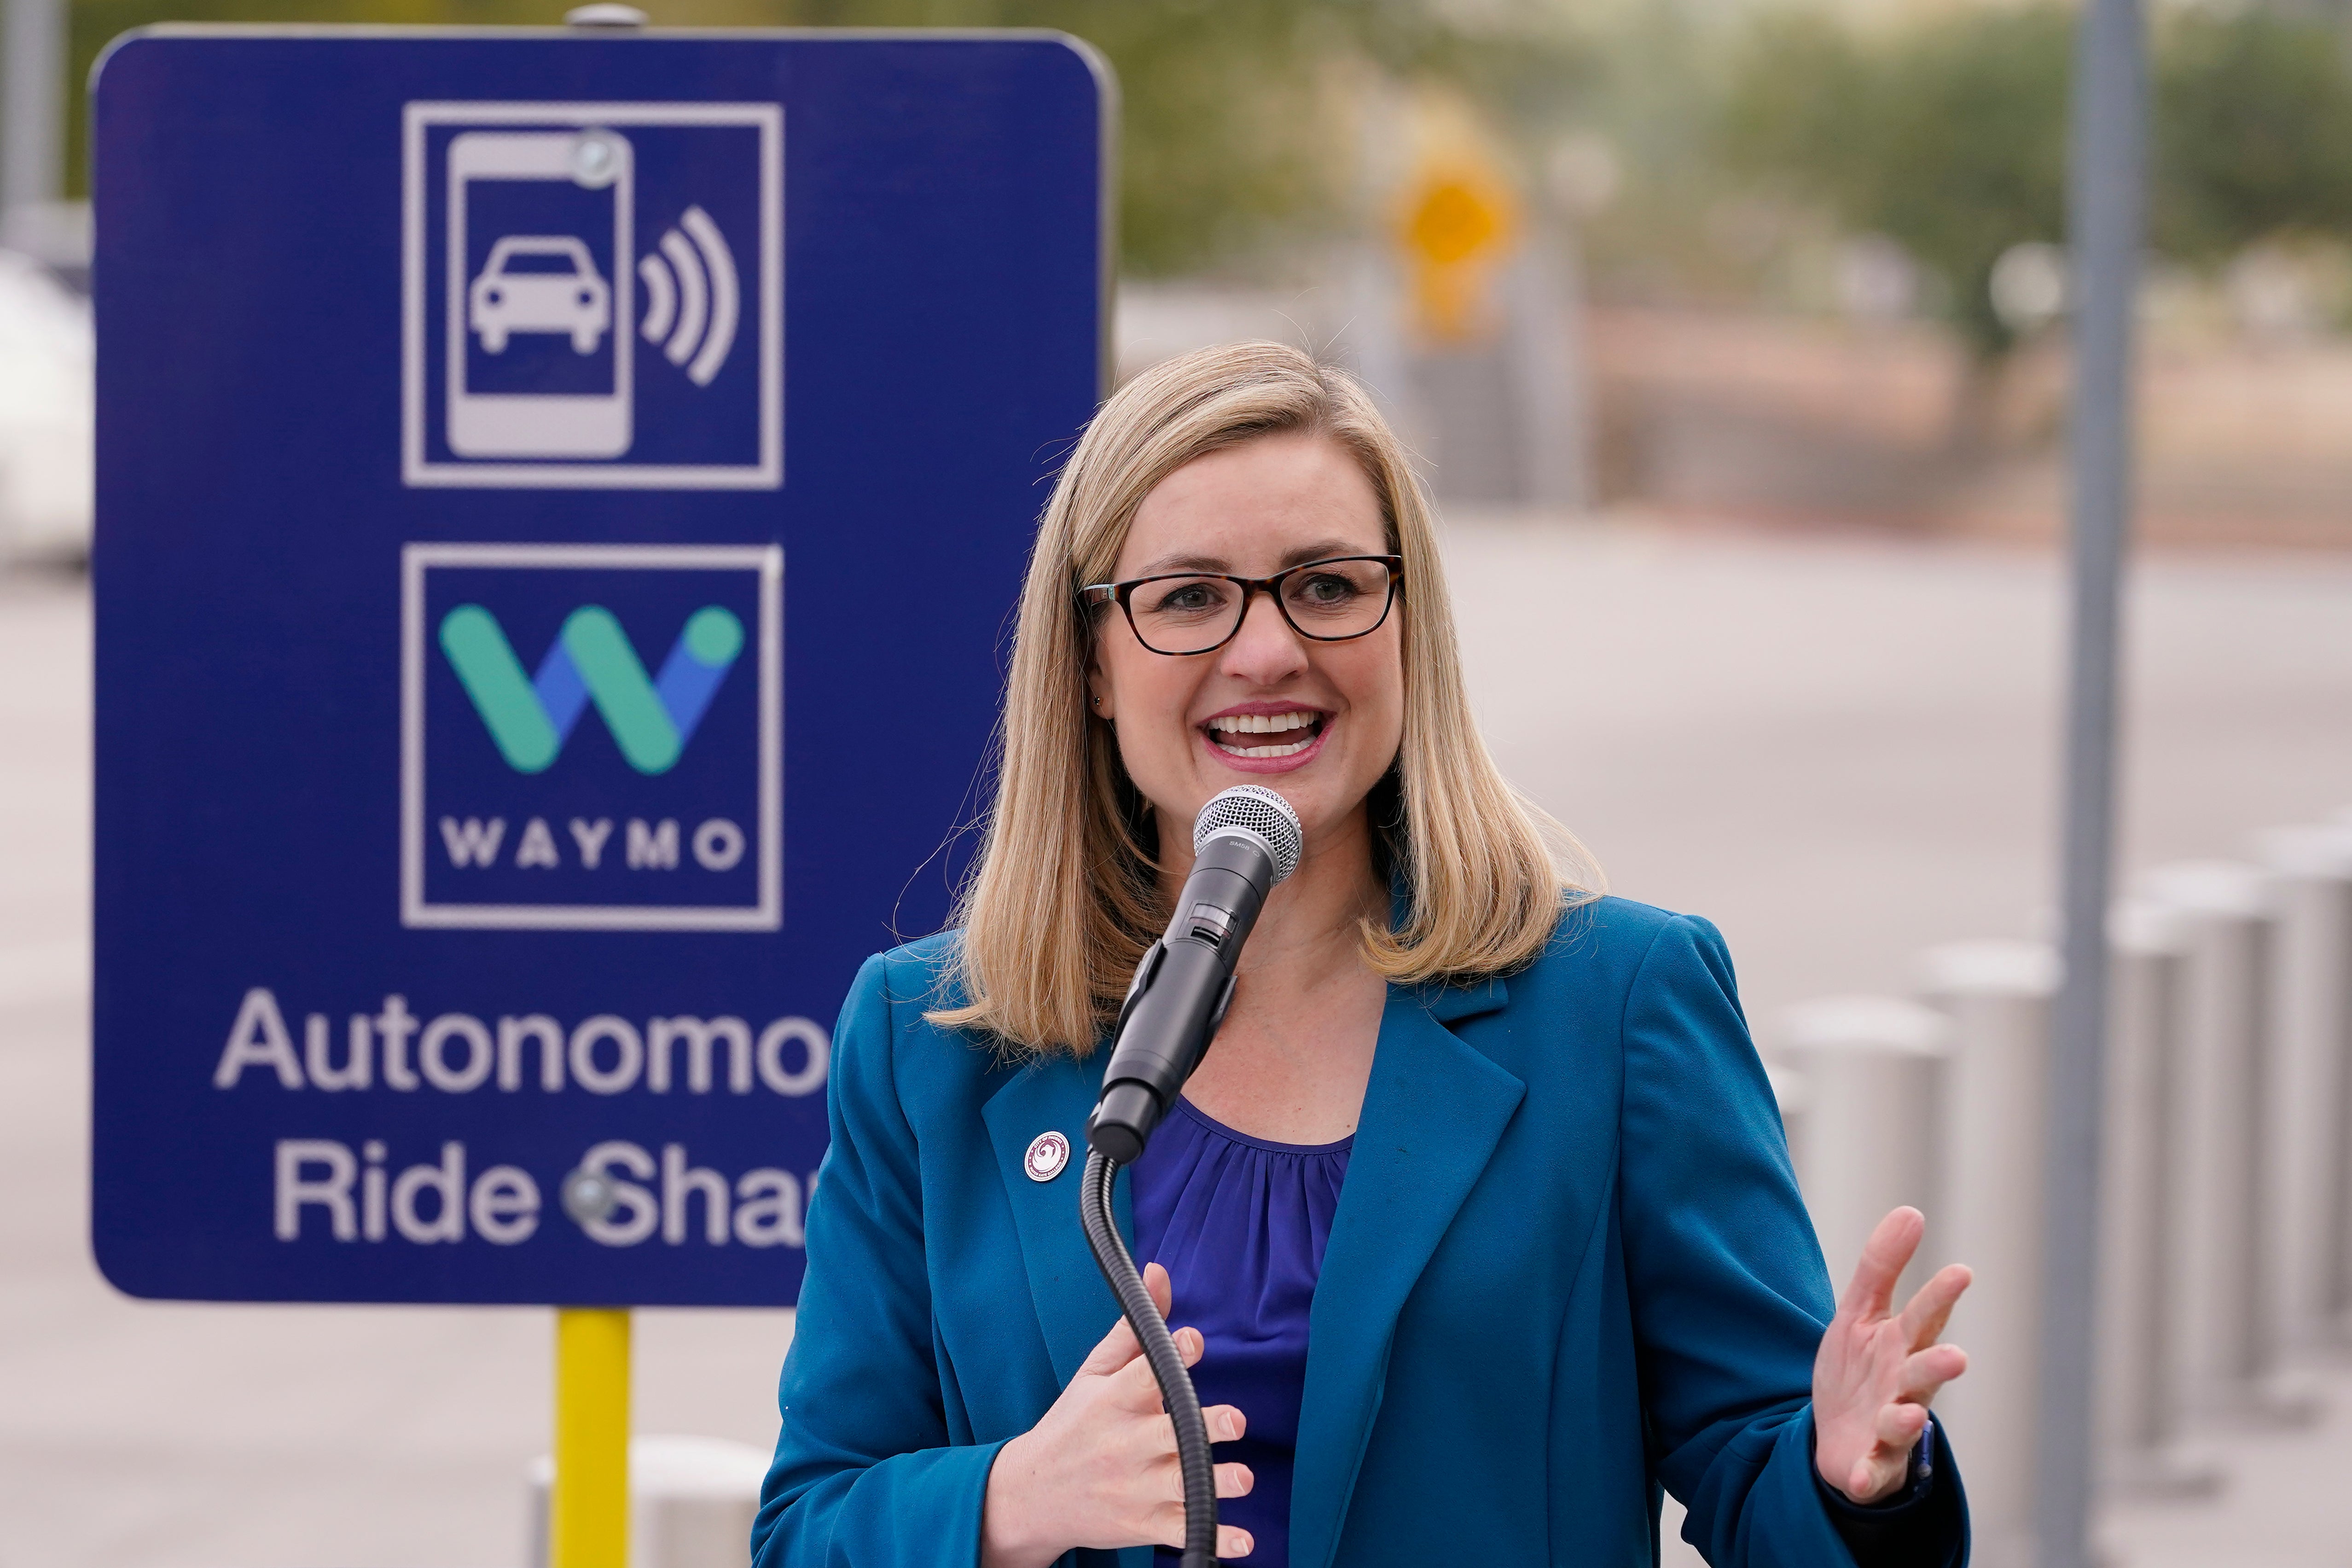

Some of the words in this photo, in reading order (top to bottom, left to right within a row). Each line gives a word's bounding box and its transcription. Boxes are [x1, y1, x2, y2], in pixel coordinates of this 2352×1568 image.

[441, 818, 744, 870] WAYMO
[1229, 841, 1250, 850] SM58
[275, 1140, 540, 1244] Ride
[575, 1140, 819, 1248] Sha
